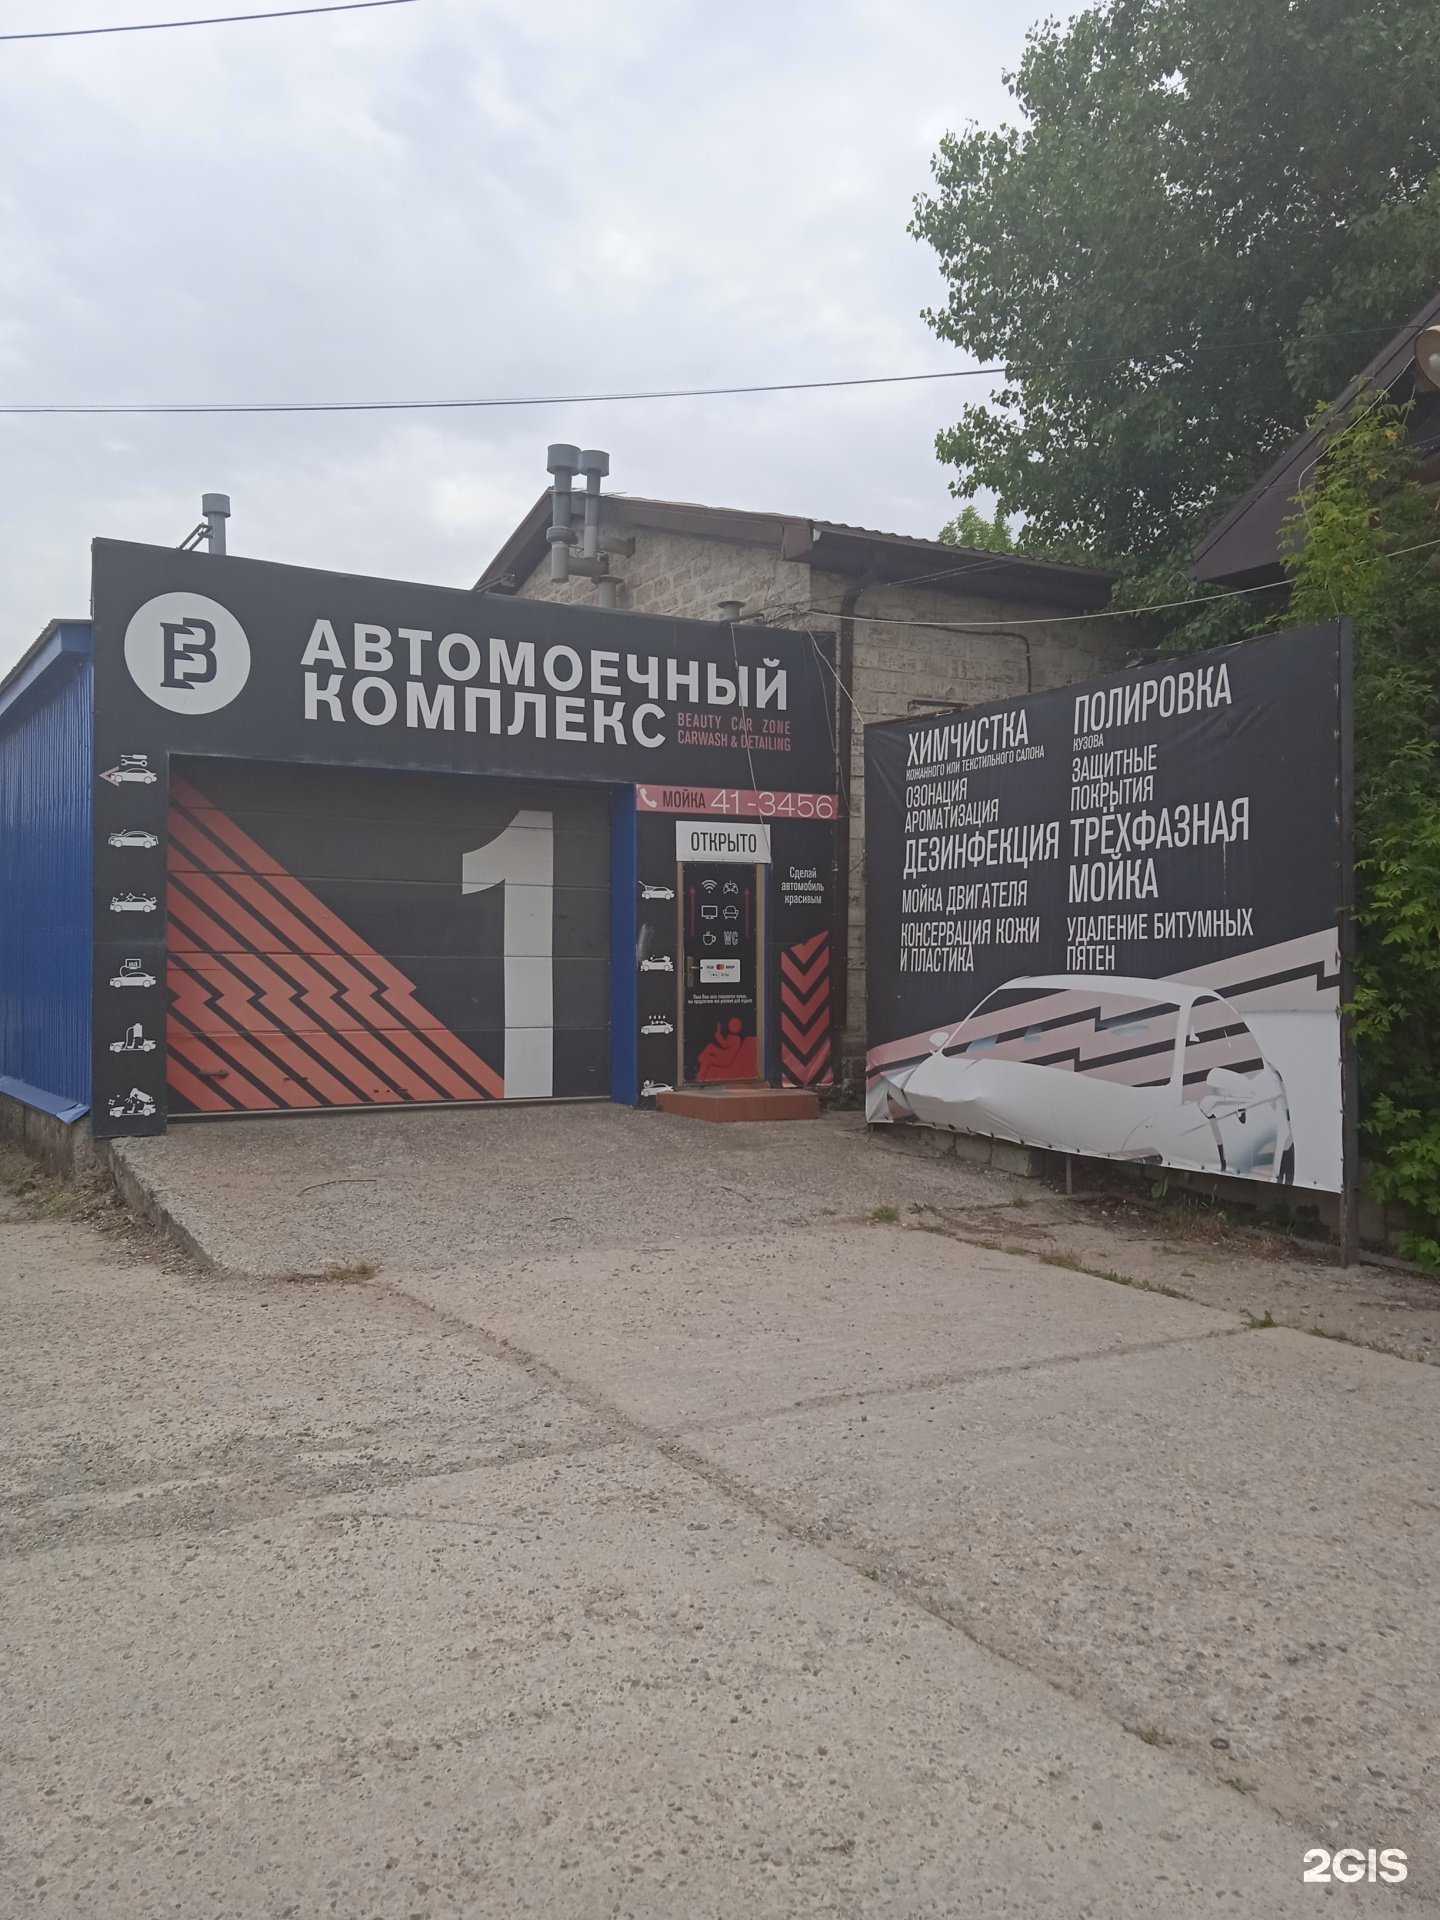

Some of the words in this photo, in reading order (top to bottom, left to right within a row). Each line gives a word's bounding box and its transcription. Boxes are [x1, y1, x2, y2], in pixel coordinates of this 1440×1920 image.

[300, 619, 788, 711] АВТОМОЕЧНЫЙ
[304, 672, 667, 749] КОМПЛЕКС
[1073, 663, 1232, 735] ПОЛИРОВКА
[678, 712, 721, 729] BEAUTY
[731, 716, 752, 731] CAR
[762, 720, 791, 735] ZONE
[678, 730, 728, 747] CARWASH
[730, 736, 738, 748] &
[741, 735, 791, 752] DETAILING
[907, 709, 1029, 766] ХИМЧИСТКА
[1072, 734, 1104, 752] КУЗОВА
[905, 763, 945, 781] КОЖАННОГО
[946, 761, 960, 775] ИЛИ
[961, 752, 1014, 772] ТЕКСТИЛЬНОГО
[1016, 745, 1045, 762] САЛОНА
[1071, 743, 1158, 784] ЗАЩИТНЫЕ
[662, 788, 706, 809] МОЙКА
[710, 789, 833, 819] 41-3456
[906, 777, 968, 808] ОЗОНАЦИЯ
[1070, 775, 1154, 812] ПОКРЫТИЯ
[904, 799, 999, 833] АРОМАТИЗАЦИЯ
[1070, 797, 1250, 858] ТРЁХФАЗНАЯ
[690, 831, 757, 854] ОТКРЫТО
[903, 821, 1060, 880] ДЕЗИНФЕКЦИЯ
[781, 880, 825, 892] автомобиль
[789, 866, 817, 880] Сделай
[1068, 852, 1159, 903] МОЙКА
[784, 895, 822, 906] красивым
[902, 883, 943, 914] МОЙКА
[946, 880, 1028, 916] ДВИГАТЕЛЯ
[901, 918, 991, 947] КОНСЕРВАЦИЯ
[995, 917, 1040, 944] КОЖИ
[1066, 914, 1148, 946] УДАЛЕНИЕ
[1153, 907, 1254, 942] БИТУМНЫХ
[462, 810, 553, 1098] 1
[899, 947, 907, 972] И
[910, 945, 974, 972] ПЛАСТИКА
[1066, 944, 1116, 972] ПЯТЕН
